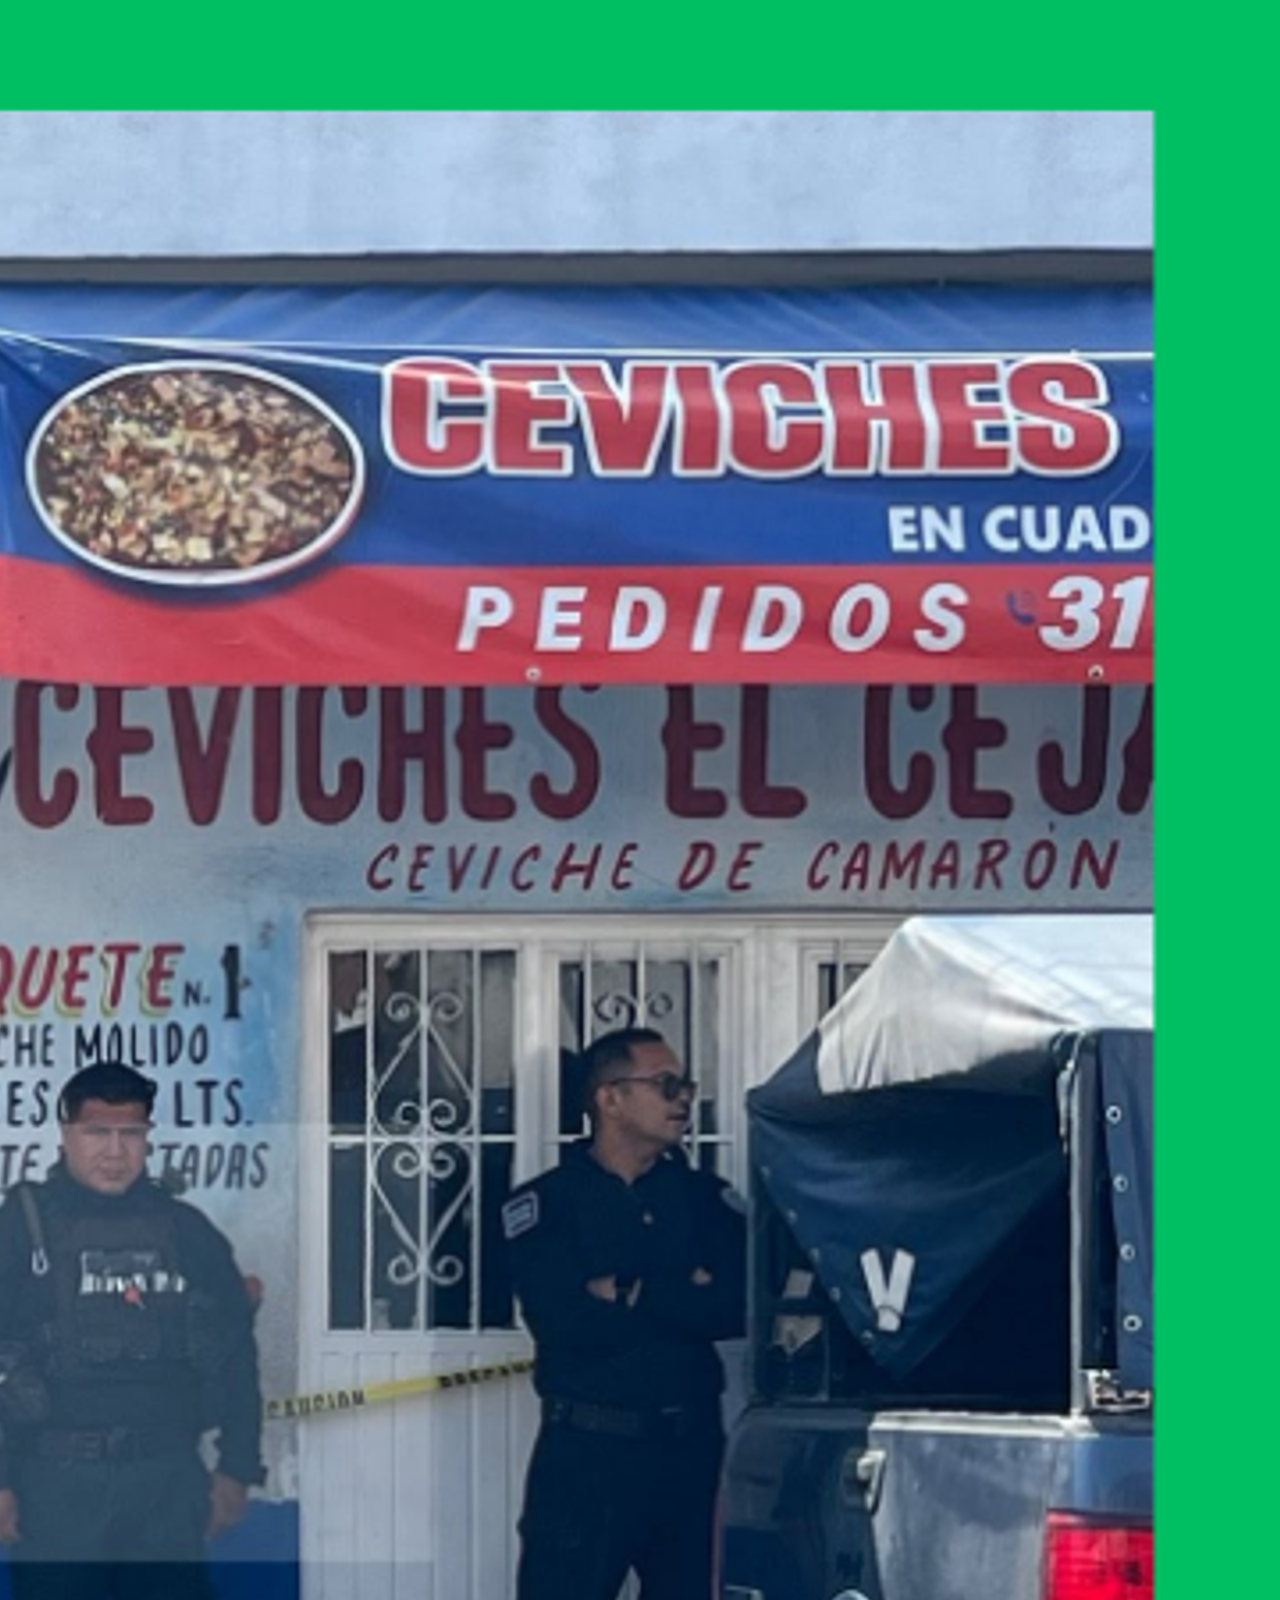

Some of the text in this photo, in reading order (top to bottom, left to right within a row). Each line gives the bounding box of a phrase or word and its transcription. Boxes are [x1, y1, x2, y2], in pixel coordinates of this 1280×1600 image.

[381, 357, 1121, 478] CEVICHES
[888, 505, 1152, 552] EN CUAD
[455, 575, 1150, 653] PEDIDOS 31
[13, 682, 601, 829] CEVICHES
[660, 685, 809, 821] EL
[366, 843, 639, 893] CEVICHE
[677, 841, 764, 892] DE
[74, 1022, 210, 1068] MOLIDO
[143, 1141, 270, 1189] TADAS
